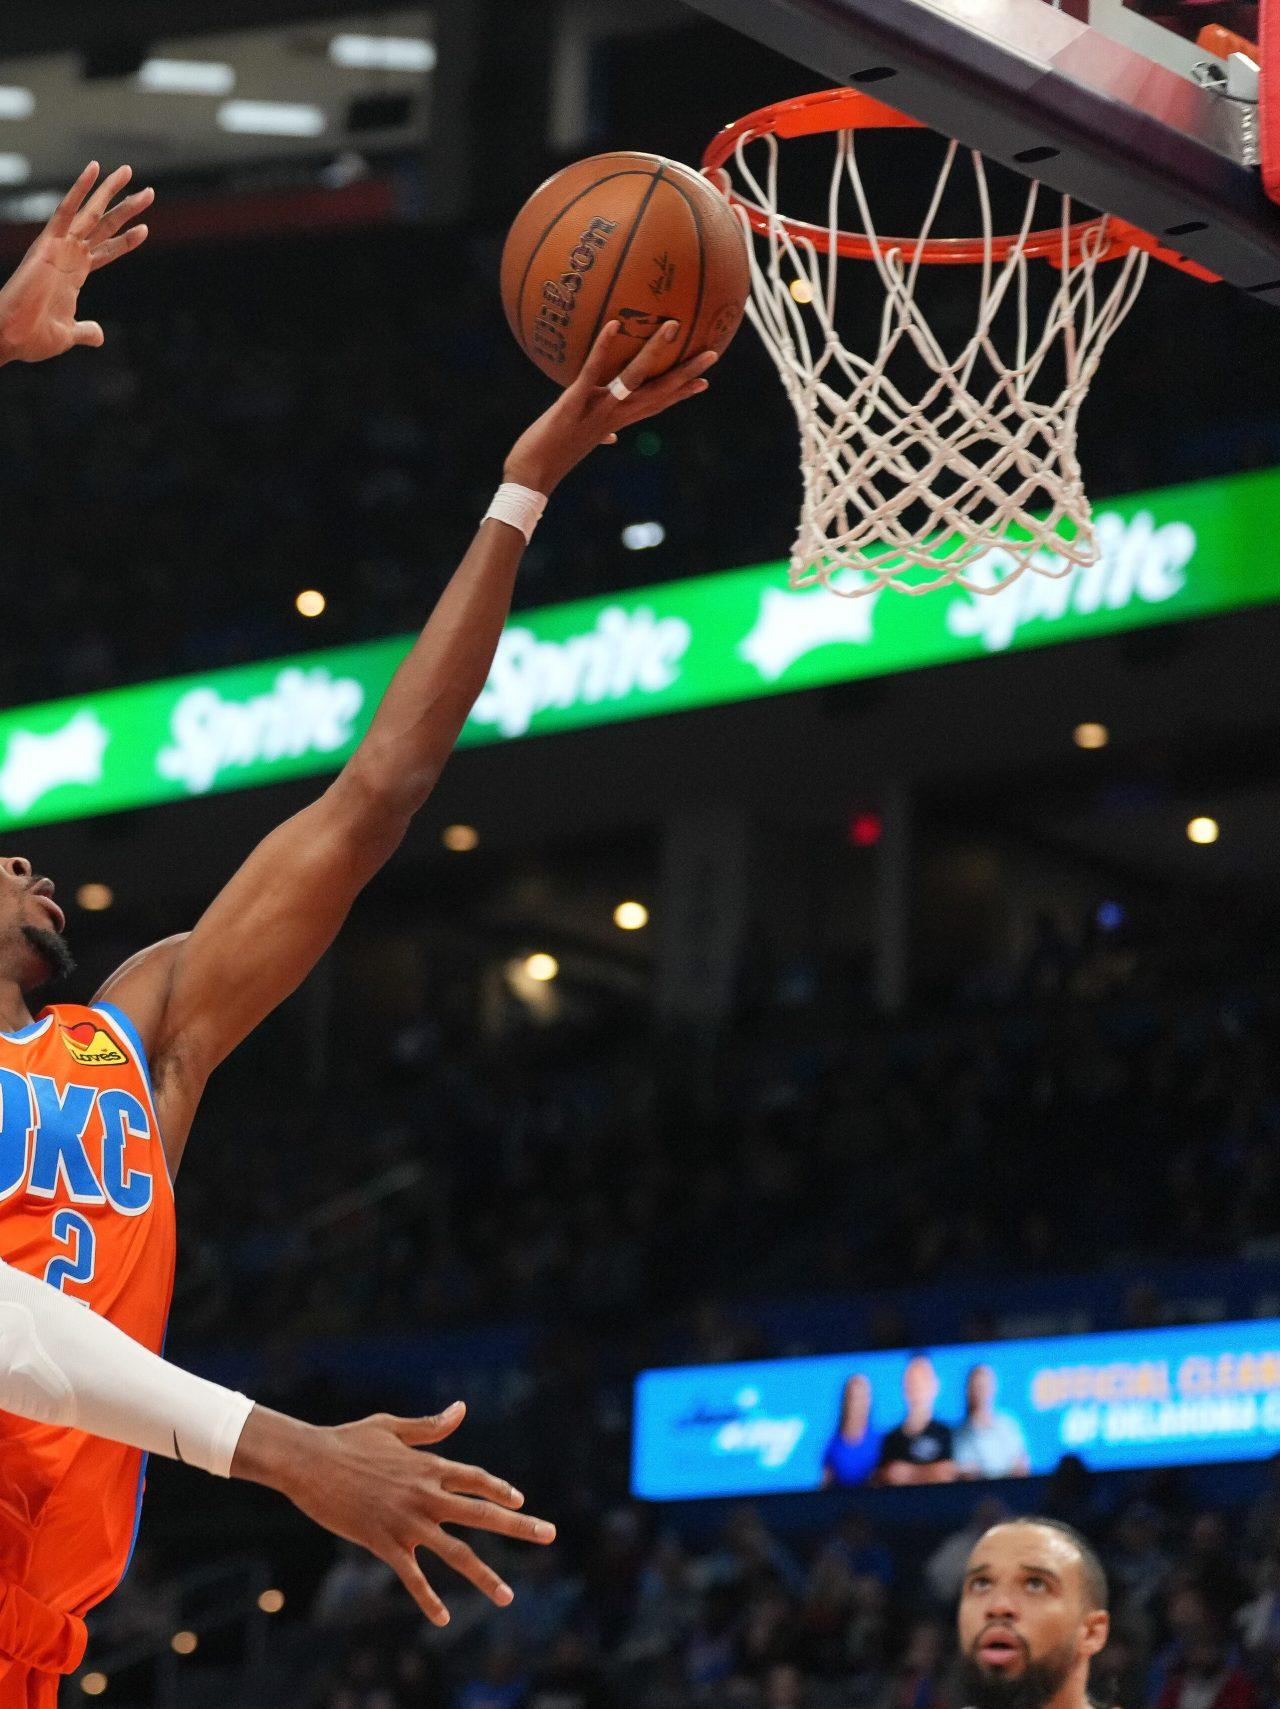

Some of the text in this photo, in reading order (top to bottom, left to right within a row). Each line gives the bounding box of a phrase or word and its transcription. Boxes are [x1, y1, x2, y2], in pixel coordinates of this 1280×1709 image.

[533, 215, 619, 366] Wilson
[156, 668, 363, 793] Sprite
[946, 508, 1196, 652] Sprite
[43, 1207, 97, 1310] 2
